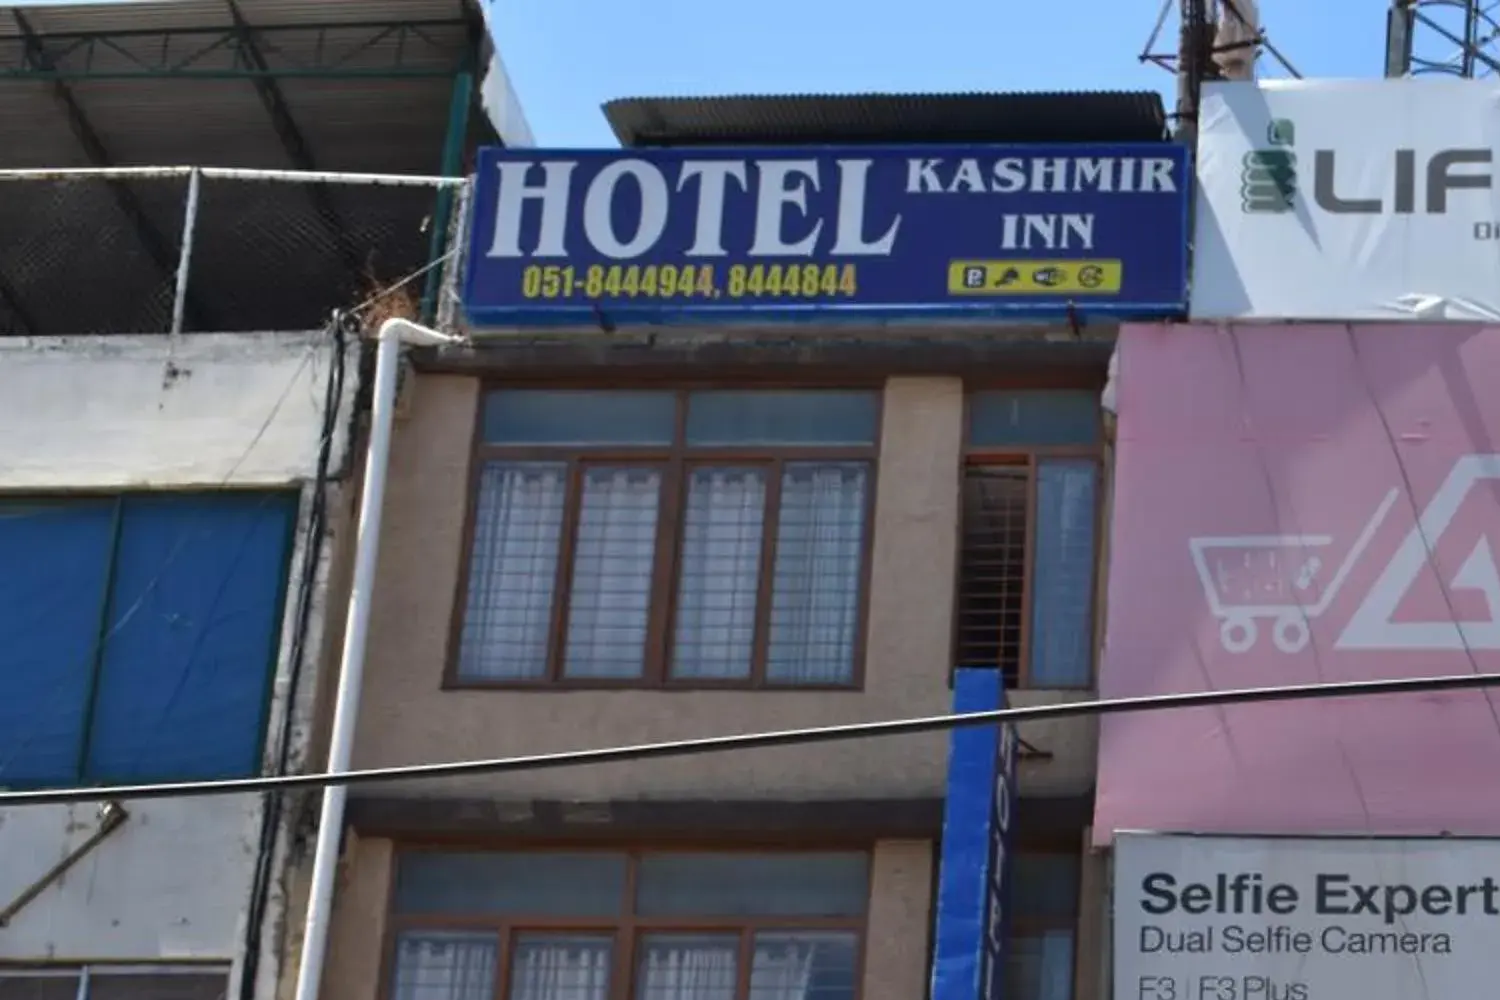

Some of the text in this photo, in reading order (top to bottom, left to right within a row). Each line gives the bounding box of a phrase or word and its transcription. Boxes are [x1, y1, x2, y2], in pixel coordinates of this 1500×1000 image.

[905, 157, 1178, 193] KASHMIR
[486, 158, 902, 259] HOTEL
[1001, 213, 1095, 249] INN
[523, 263, 857, 299] 051-8444944, 8444844
[1140, 872, 1500, 923] Selfie Expert
[1139, 926, 1452, 954] Dual Selfie Camera
